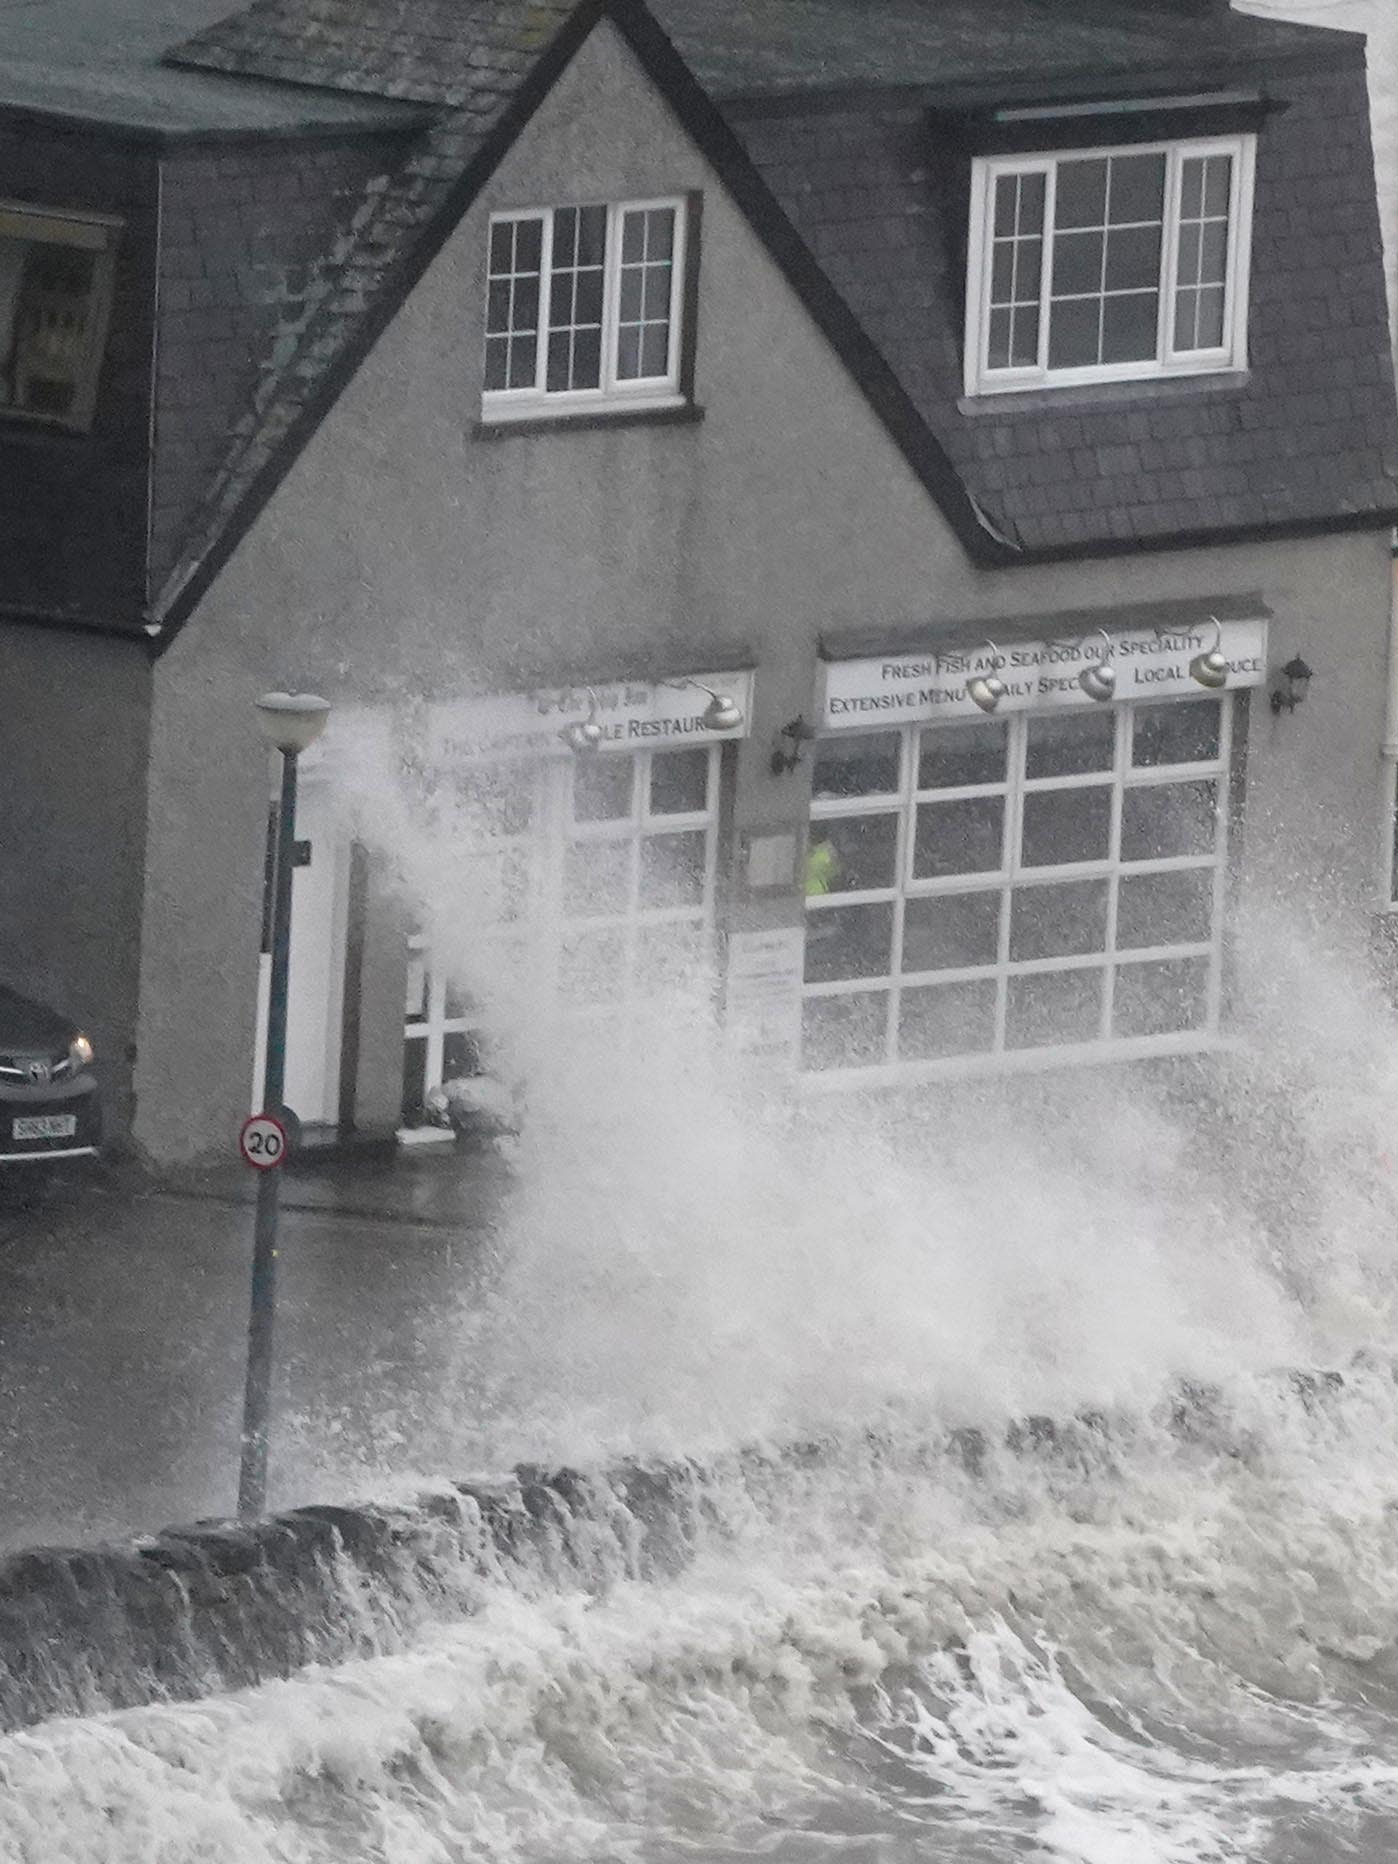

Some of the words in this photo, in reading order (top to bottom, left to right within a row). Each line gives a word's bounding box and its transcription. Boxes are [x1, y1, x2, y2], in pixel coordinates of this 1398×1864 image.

[881, 661, 932, 680] FRESH
[974, 654, 1007, 673] AND
[829, 692, 917, 715] EXTENSIVE
[918, 687, 967, 706] MENU
[1002, 680, 1034, 696] AILY
[1133, 664, 1186, 684] LOCAL
[627, 716, 705, 740] RESTAUR
[247, 1131, 281, 1156] 20
